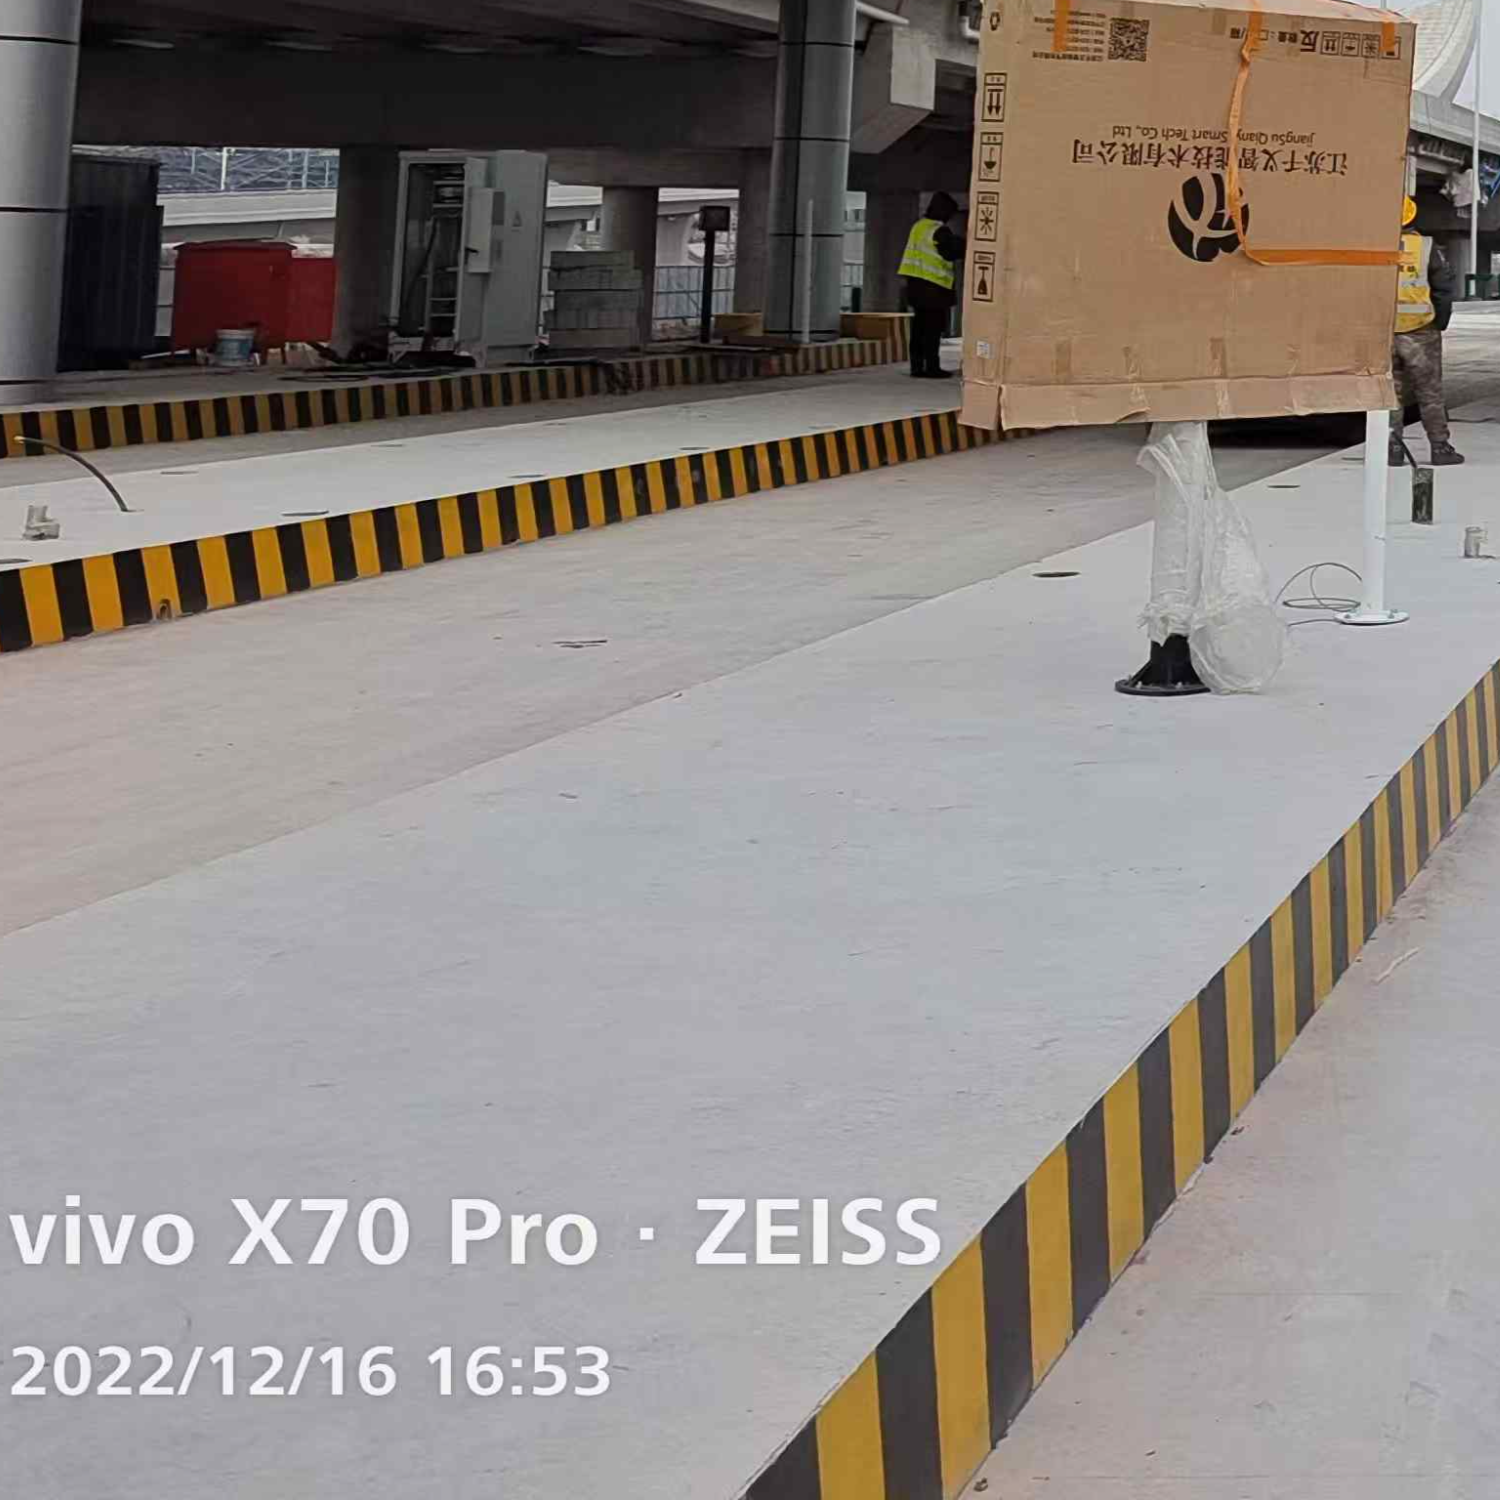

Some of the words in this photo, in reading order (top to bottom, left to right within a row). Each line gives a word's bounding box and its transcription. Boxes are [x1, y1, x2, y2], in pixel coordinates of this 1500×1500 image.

[1112, 125, 1132, 138] Ltd
[1162, 127, 1189, 141] Tech
[1192, 129, 1228, 143] Smart
[1072, 138, 1348, 175] 江苏千义智能技术有限公司
